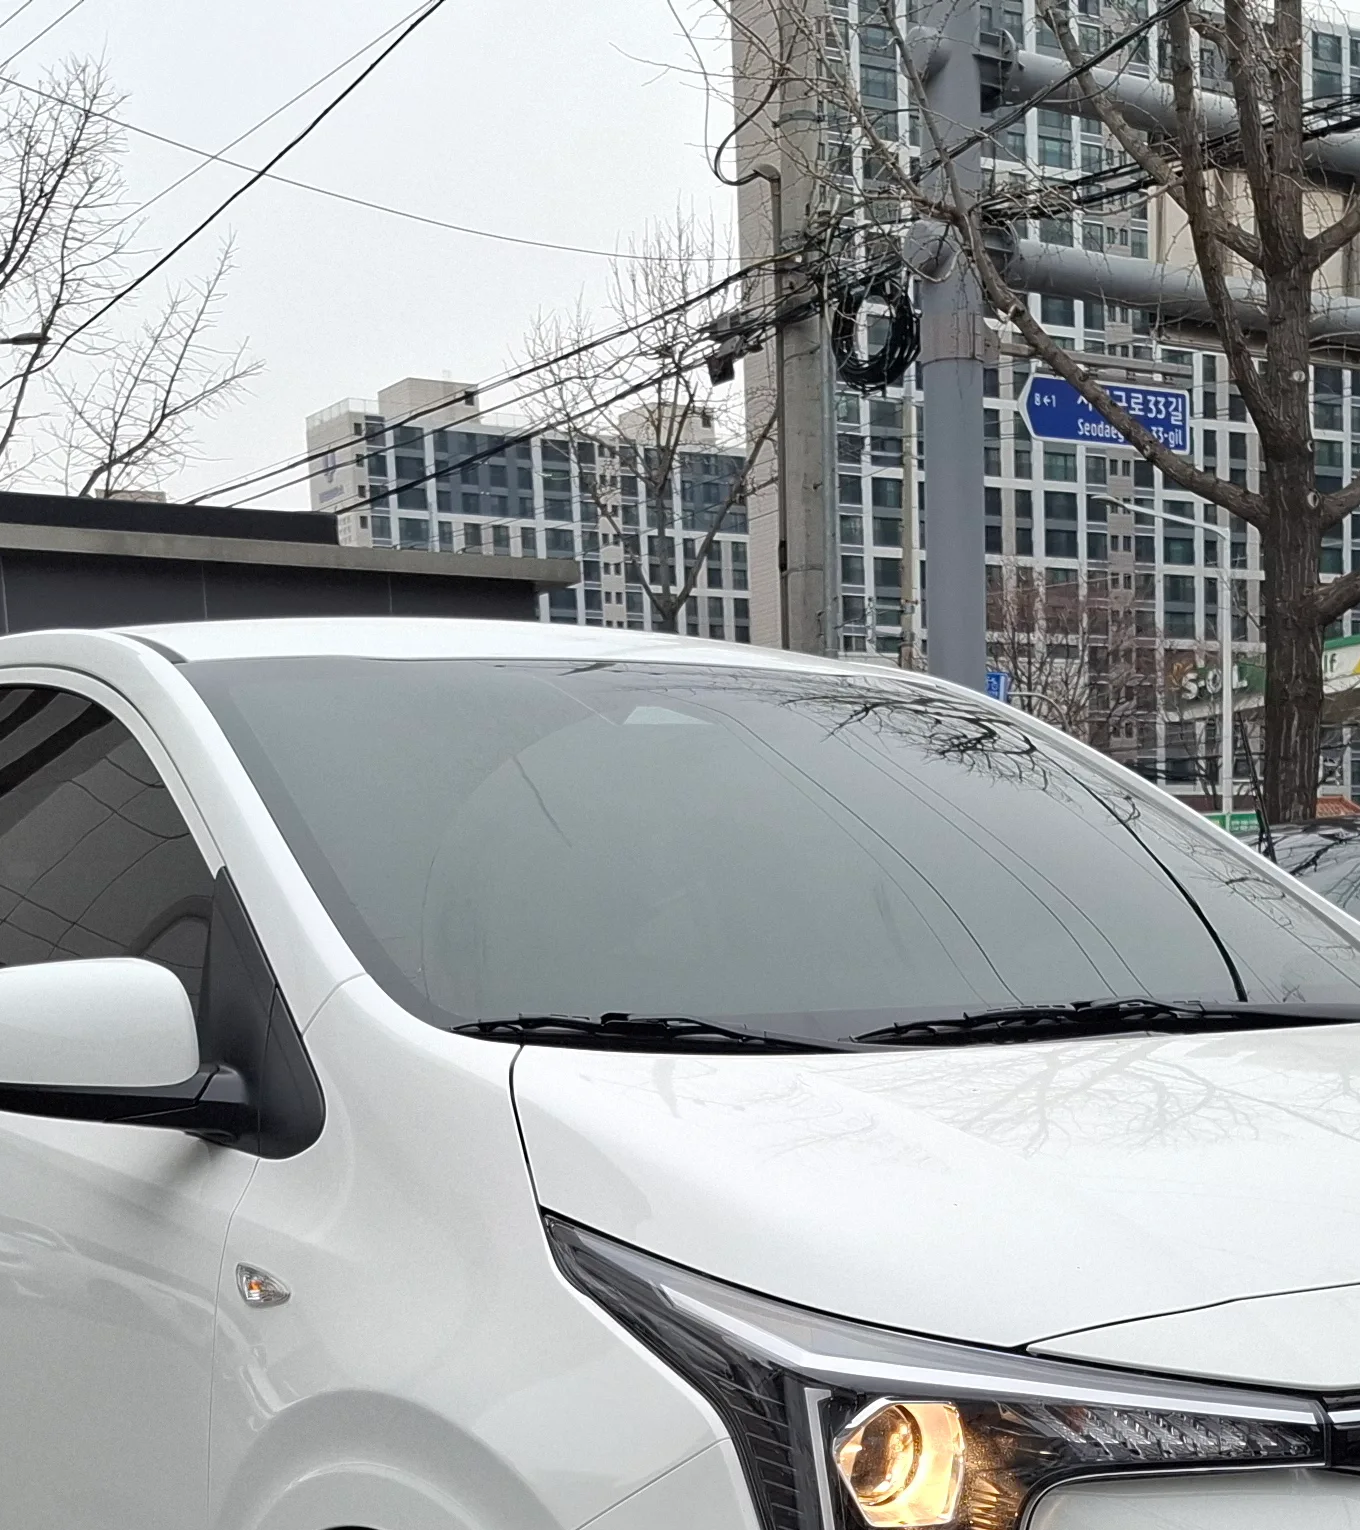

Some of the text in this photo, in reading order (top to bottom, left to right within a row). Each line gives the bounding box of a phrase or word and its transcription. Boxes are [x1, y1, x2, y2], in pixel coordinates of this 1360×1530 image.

[1077, 390, 1183, 426] 구로33길
[1077, 419, 1125, 443] Seodaeg
[1181, 664, 1248, 700] S-OL
